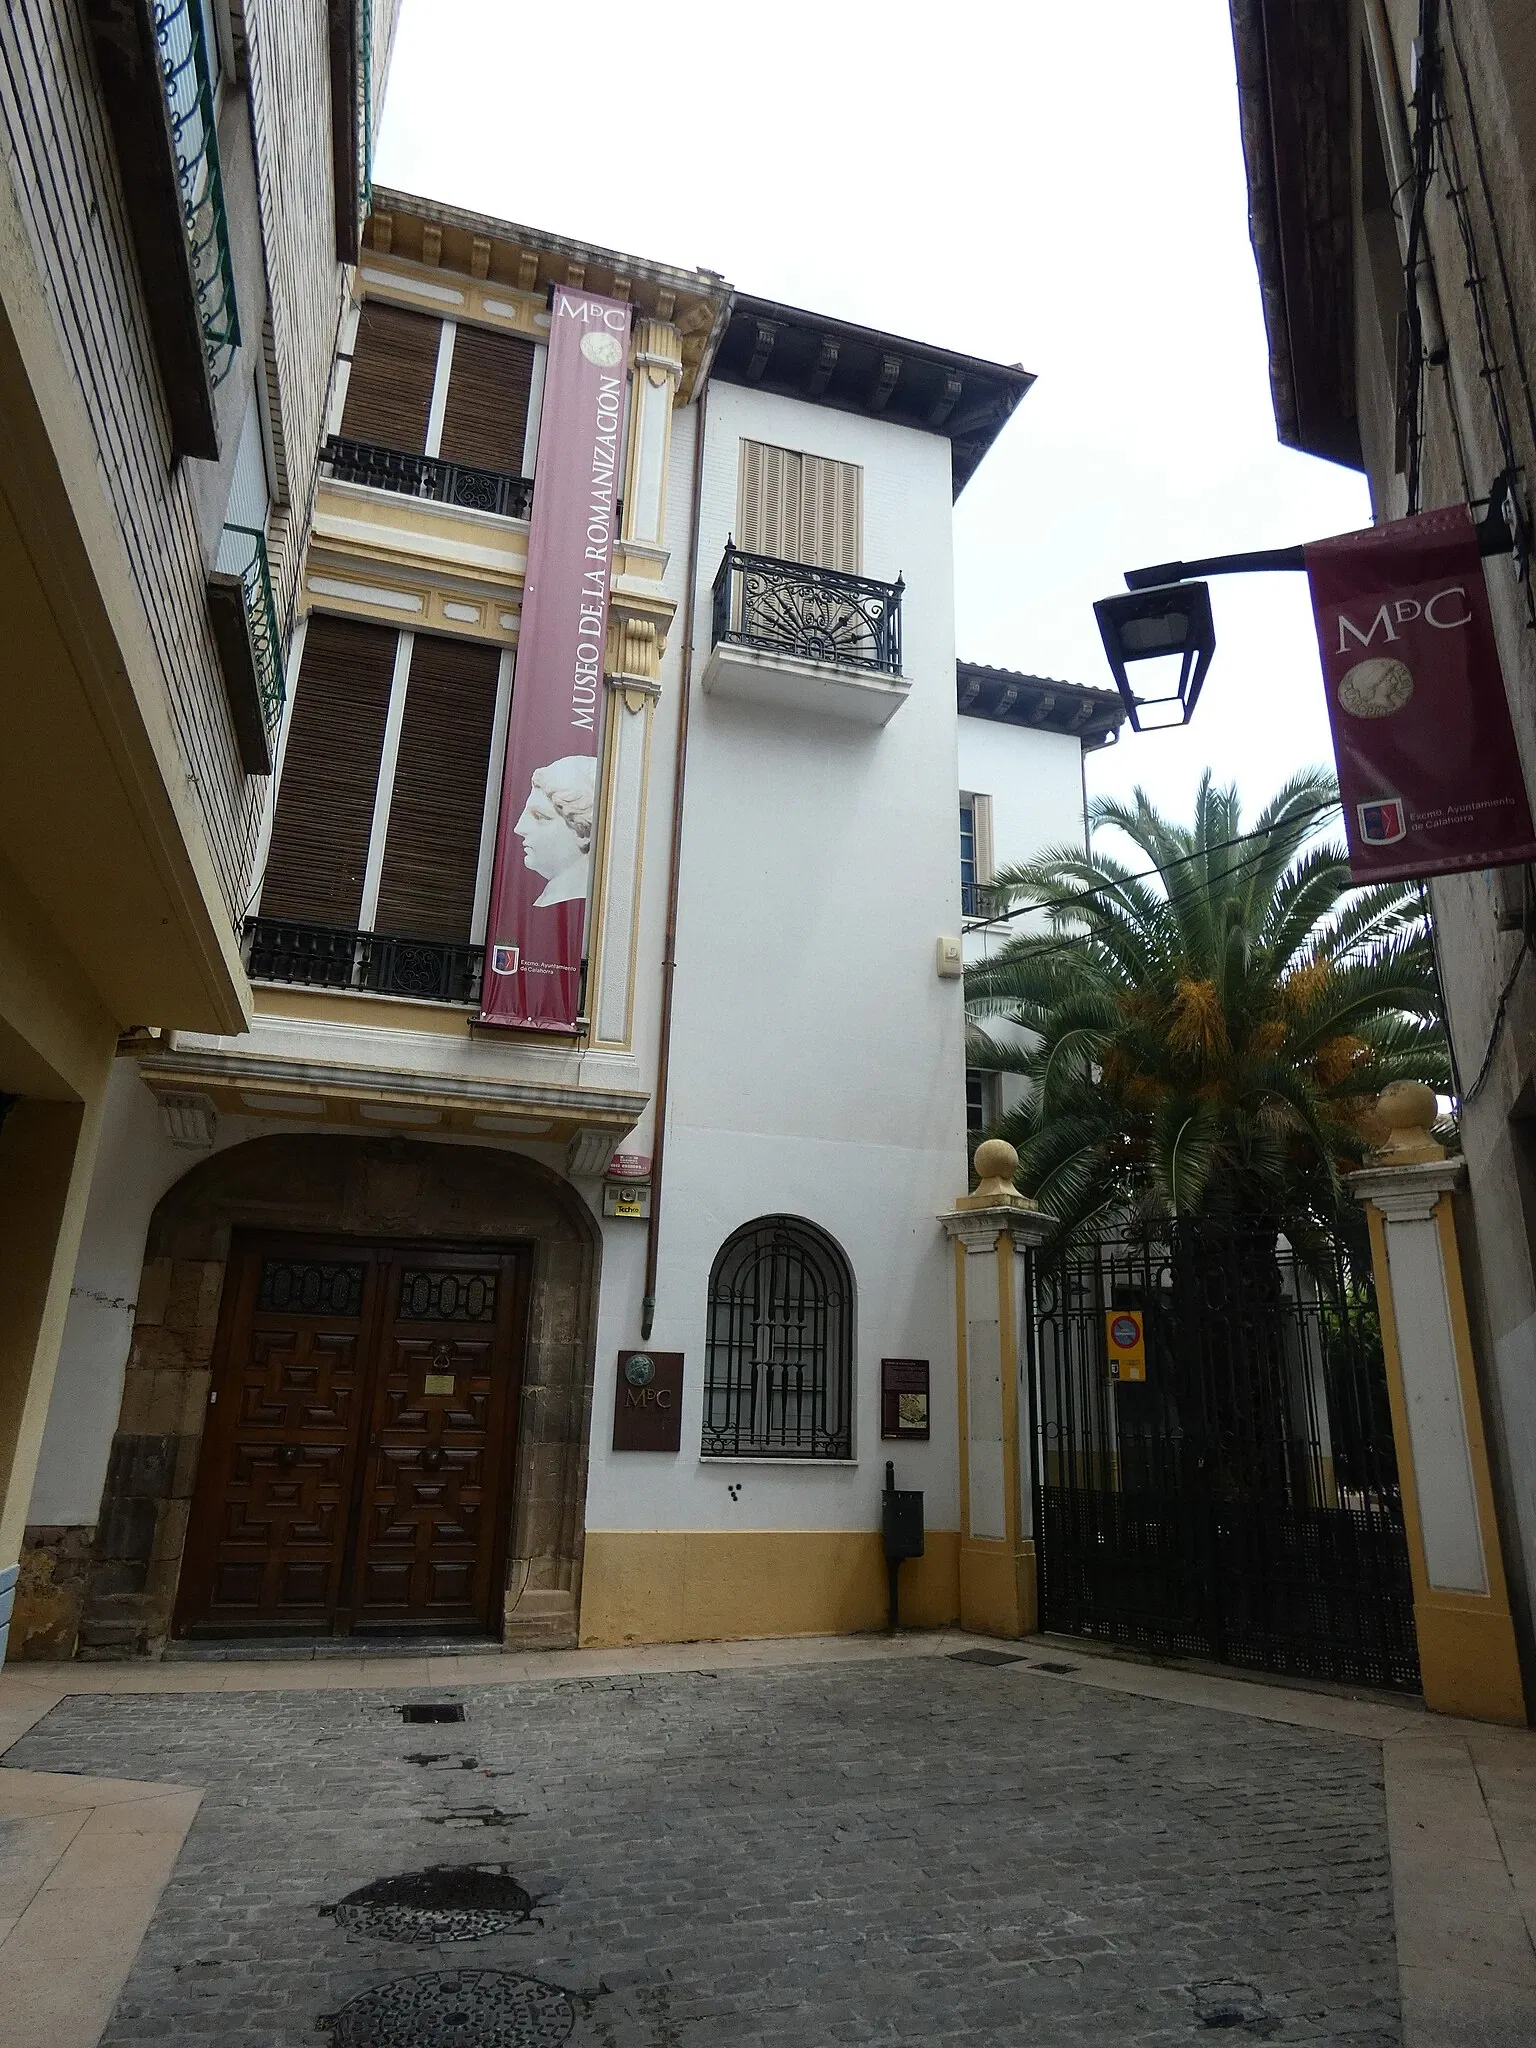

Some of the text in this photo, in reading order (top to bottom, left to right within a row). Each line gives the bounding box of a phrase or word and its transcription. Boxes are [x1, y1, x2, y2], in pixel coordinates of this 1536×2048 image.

[570, 374, 622, 732] MUSEO DE LA ROMANIZACIÓN
[1447, 796, 1516, 815] Ayuntamiento
[1411, 814, 1474, 832] de Calahorra
[527, 966, 554, 974] Calahorra
[541, 962, 577, 972] Ayuntamiento
